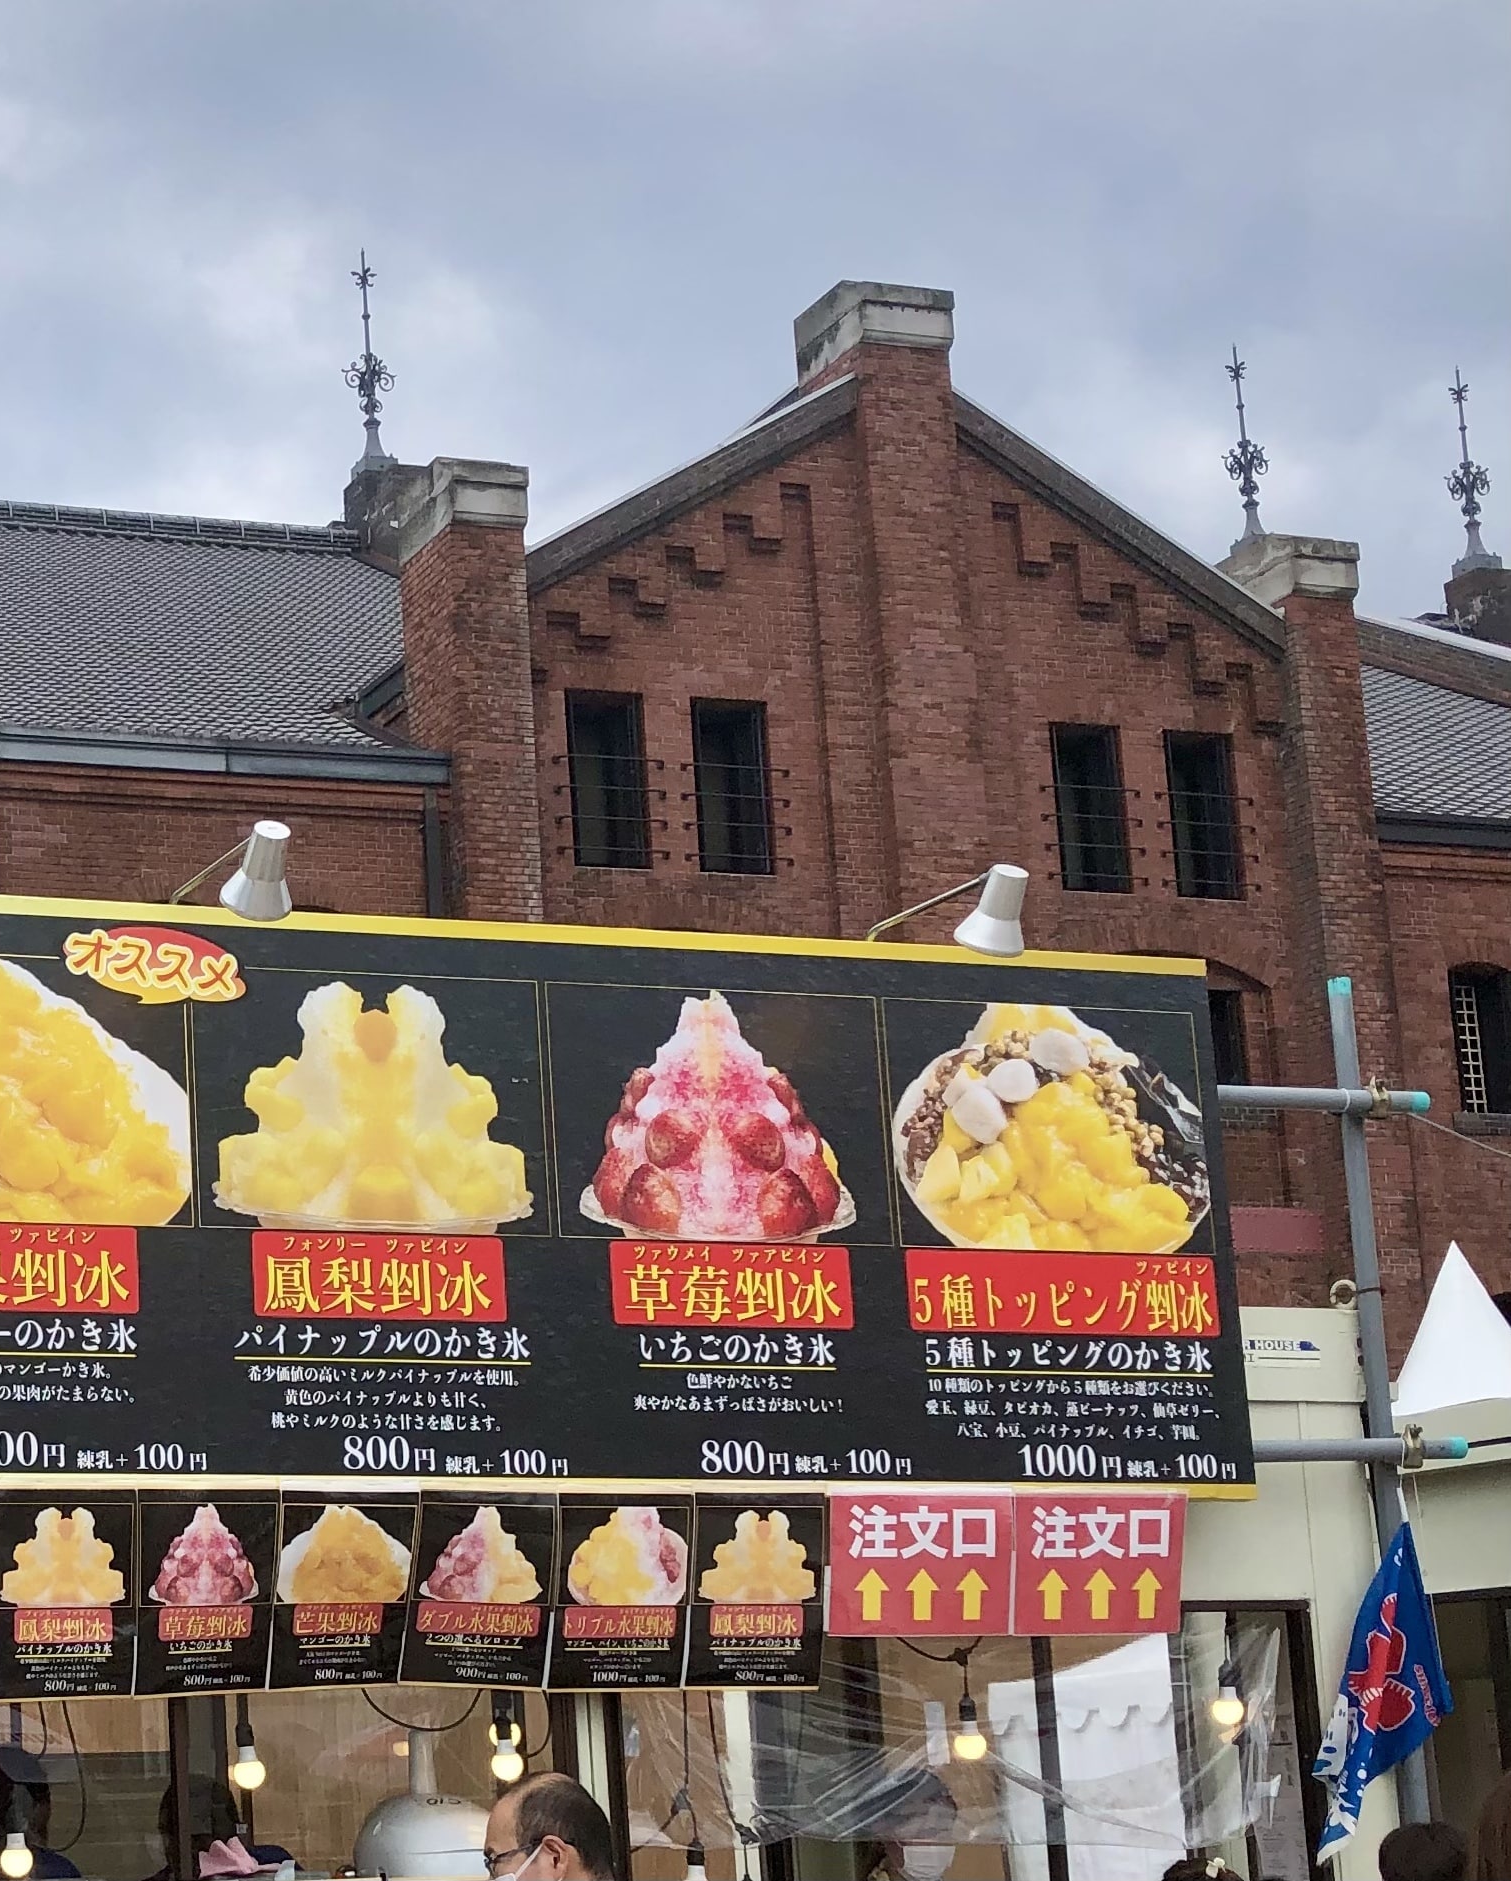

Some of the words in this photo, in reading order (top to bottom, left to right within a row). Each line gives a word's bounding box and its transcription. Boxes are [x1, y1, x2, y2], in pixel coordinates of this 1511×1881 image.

[71, 932, 232, 994] オススメ
[234, 1323, 531, 1361] パイナップルのかき氷
[639, 1331, 836, 1366] いちごのかき氷
[925, 1336, 1212, 1373] 5種トッピングのかき氷
[1255, 1340, 1301, 1351] HOUSE
[283, 1389, 488, 1410] 黄色のパイナップルよりも甘く、
[686, 1373, 793, 1390] 色鮮やかないちご
[270, 1411, 503, 1432] 桃やミルクのような甘さを感じます。
[342, 1435, 436, 1472] 800円
[700, 1439, 790, 1475] 800円
[1017, 1444, 1123, 1479] 1000円
[848, 1504, 997, 1560] 注文口
[1031, 1505, 1171, 1560] 注文口
